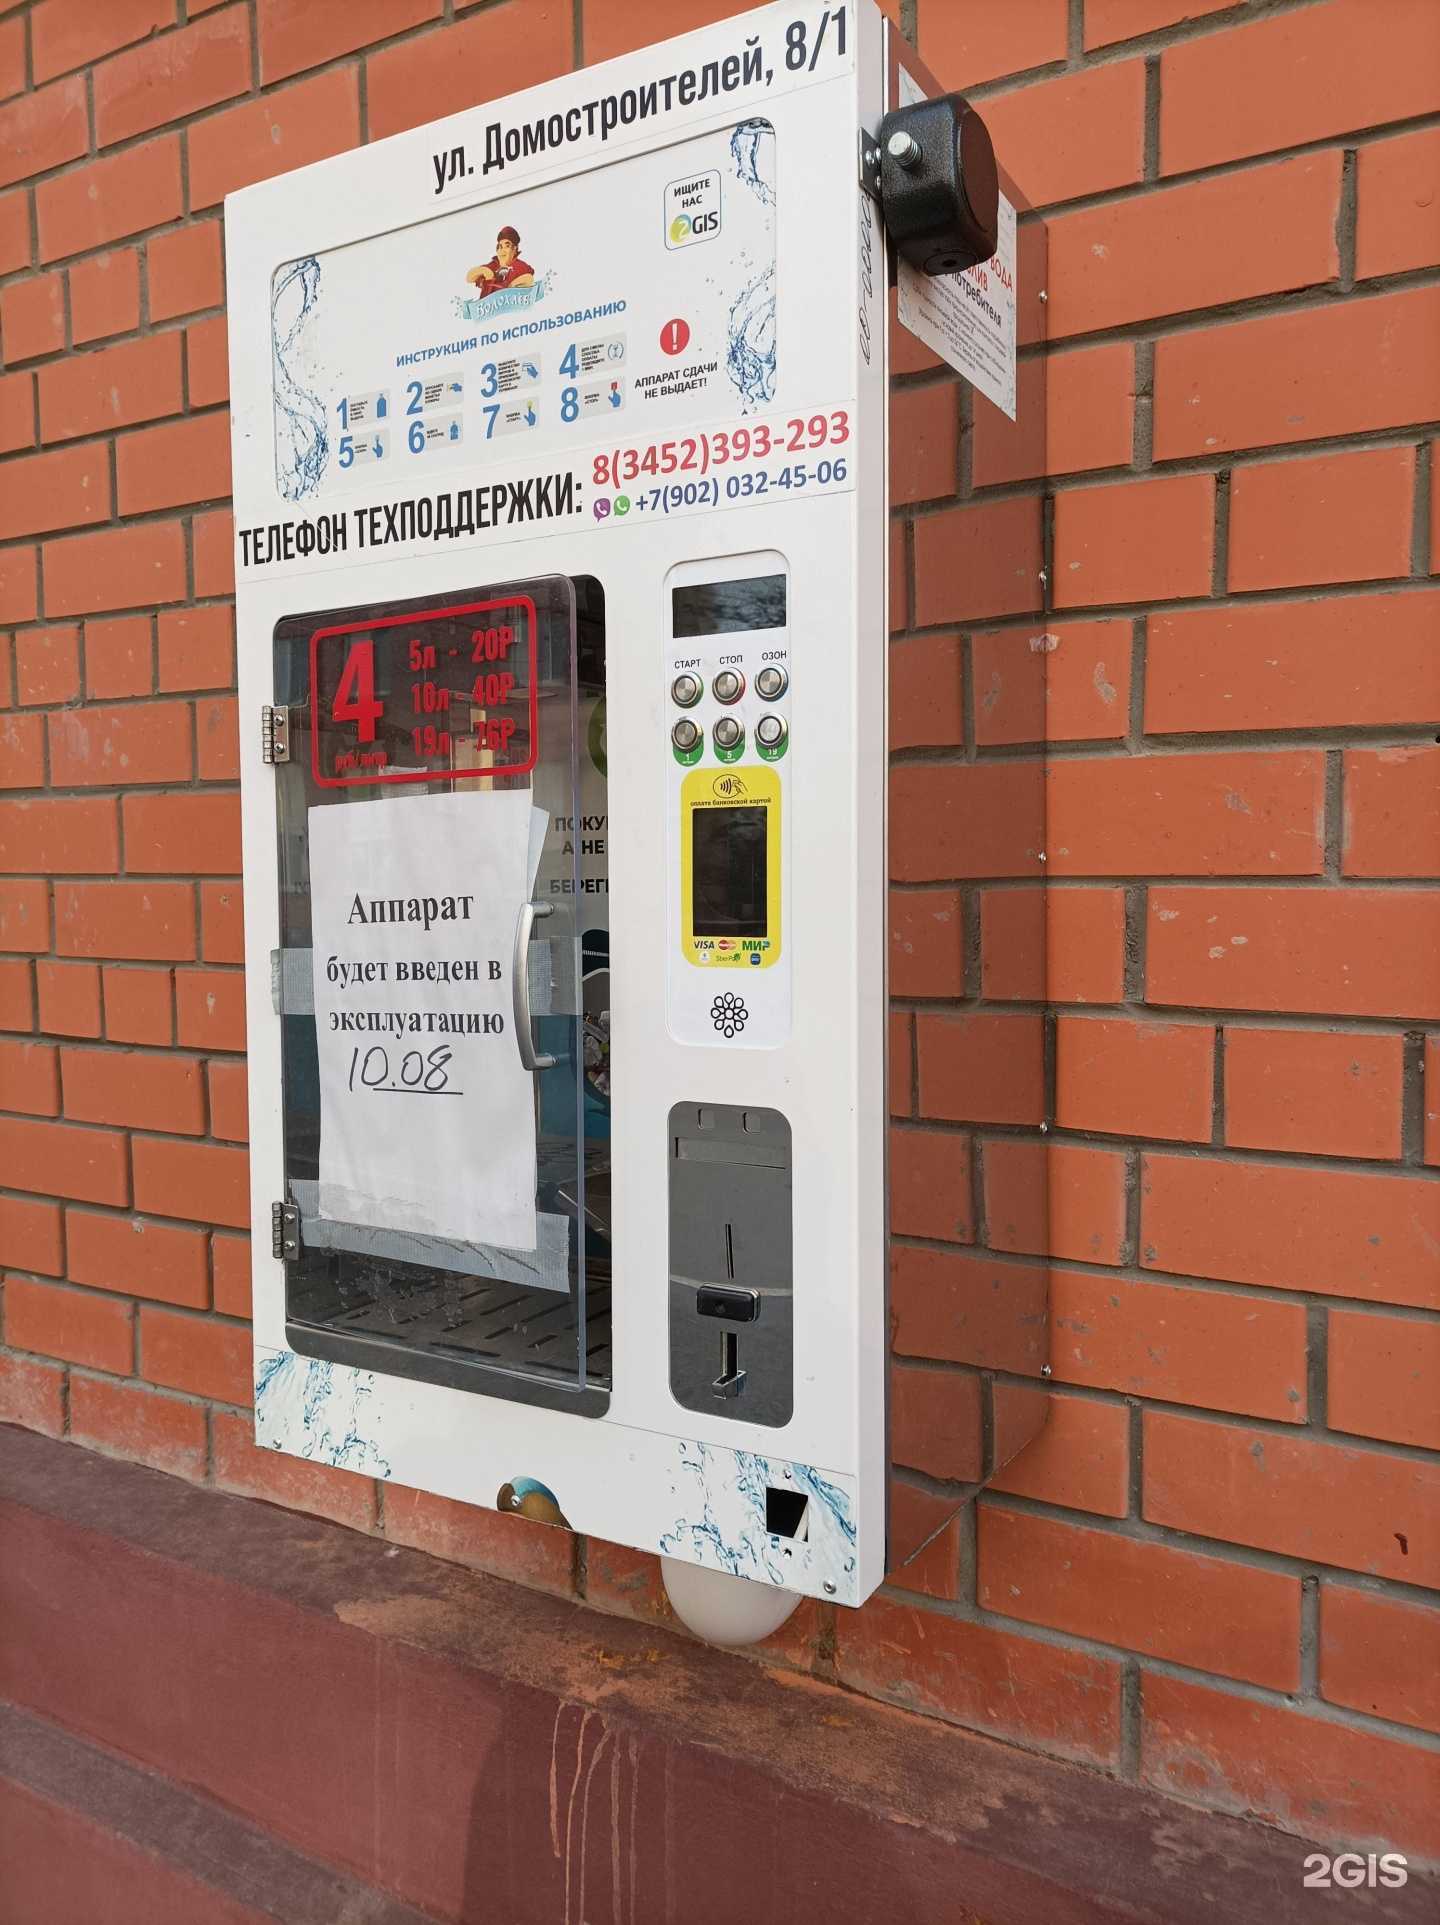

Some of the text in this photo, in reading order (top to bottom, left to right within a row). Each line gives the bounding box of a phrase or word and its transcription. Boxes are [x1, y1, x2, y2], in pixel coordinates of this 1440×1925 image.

[433, 6, 846, 194] ул. Домостроителей, 8/1
[673, 179, 711, 197] ИЩИТЕ
[681, 195, 703, 208] НАС
[670, 211, 718, 243] 2GIS
[989, 255, 1013, 292] ВОДА
[396, 299, 627, 367] ИНСТРУКЦИЯ ПО ИСПОЛЬЗОВАНИЮ
[559, 343, 579, 379] 4
[634, 361, 718, 389] АППАРАТ СДАЧИ
[480, 363, 498, 398] 3
[644, 377, 707, 400] НЕ ВЫДАЕТ!
[336, 397, 347, 430] 1
[406, 381, 423, 415] 2
[561, 387, 579, 422] 8
[408, 420, 425, 454] 6
[483, 404, 500, 439] 7
[339, 435, 354, 468] 5
[592, 411, 850, 489] 8(3452)393-293
[635, 458, 848, 513] +7(902) 032-45-06
[239, 471, 582, 566] ТЕЛЕФОН ТЕХПОДДЕРЖКИ:
[408, 639, 436, 673] 5л
[471, 627, 513, 664] 20Р
[674, 658, 702, 670] СТАРТ
[719, 654, 743, 665] СТОП
[761, 650, 787, 661] ОЗОН
[332, 639, 384, 743] 4
[411, 681, 449, 715] 10л
[472, 671, 515, 706] 40Р
[411, 725, 449, 758] 19л
[554, 815, 608, 832] ПОКУ
[562, 839, 604, 855] А НЕ
[347, 893, 473, 931] Аппарат
[693, 941, 715, 950] VISA
[742, 940, 770, 951] МИР
[327, 955, 502, 989] будет введен в
[329, 1011, 504, 1040] эксплуатацию
[349, 1044, 452, 1092] 10.08
